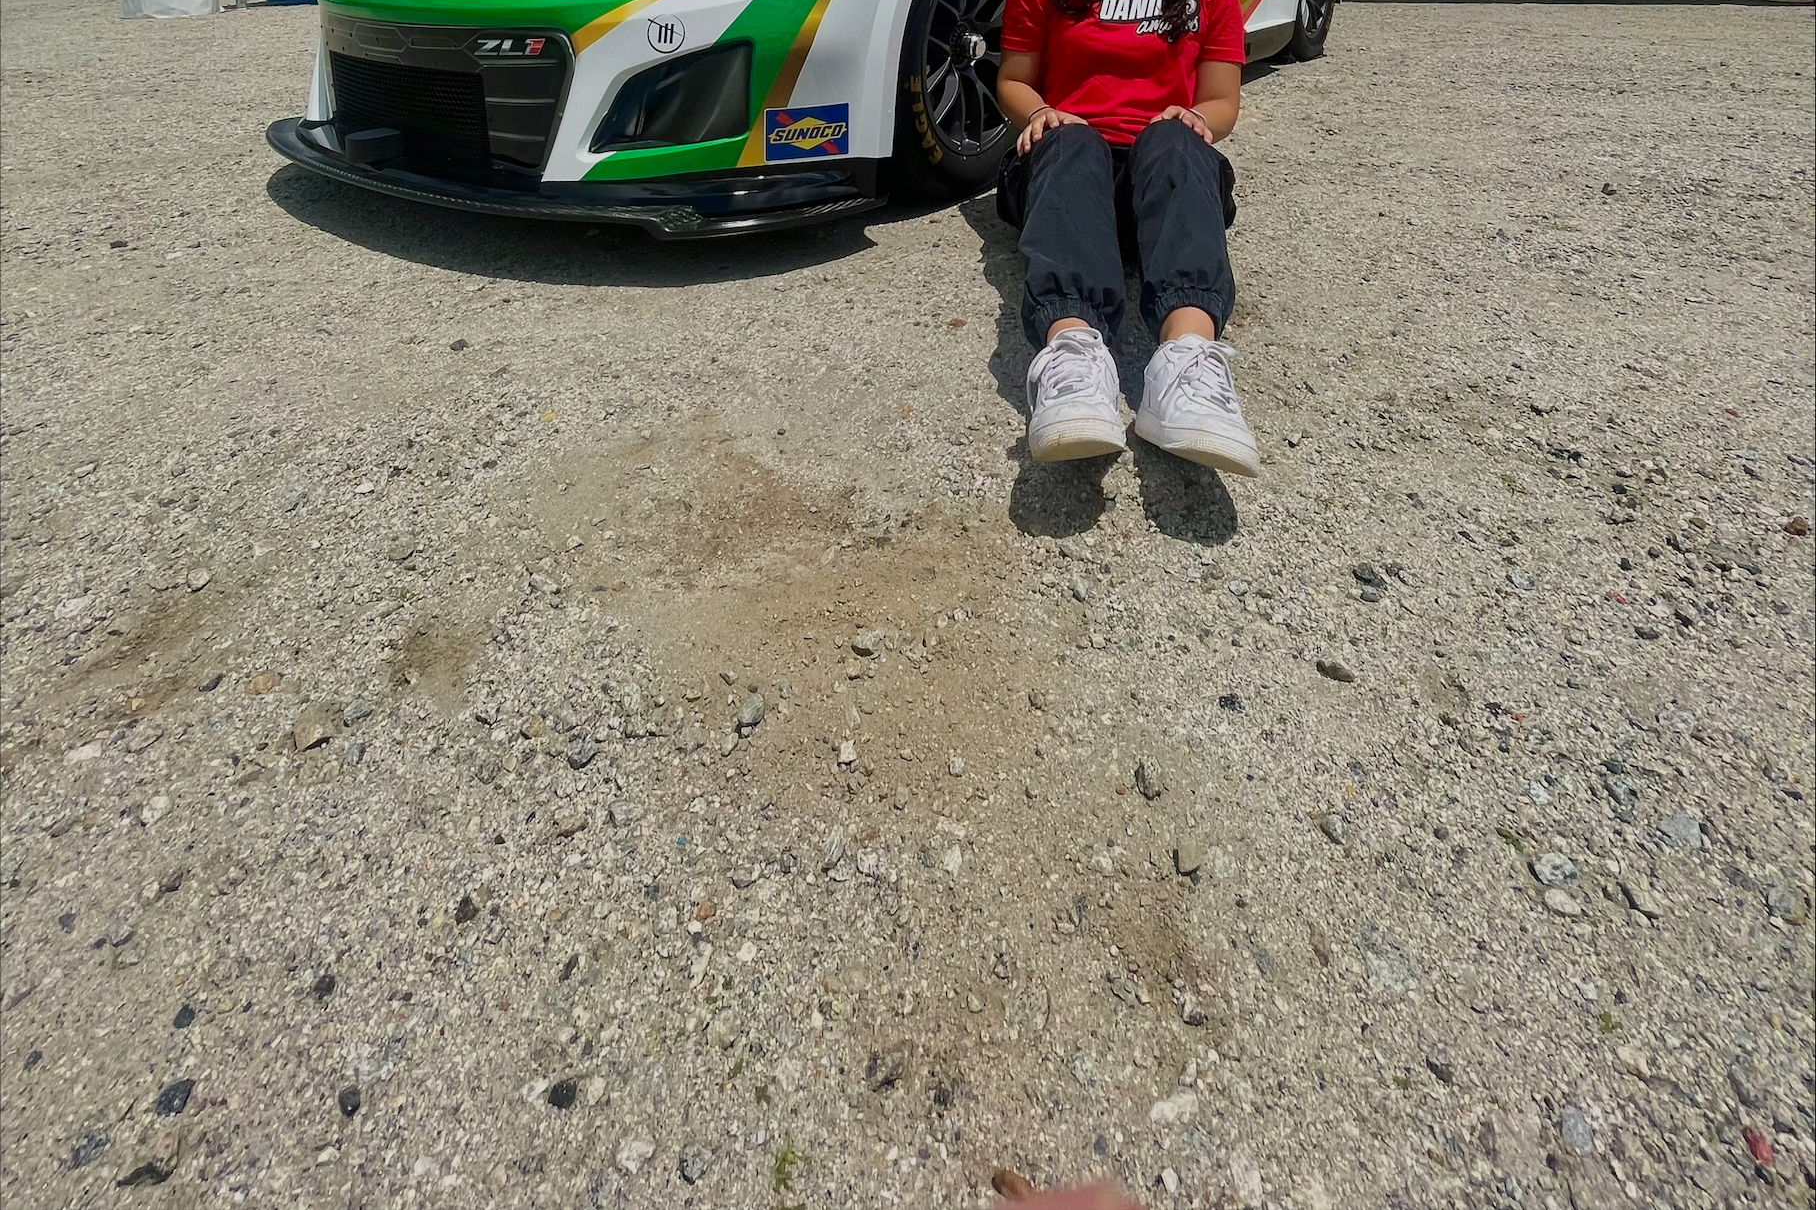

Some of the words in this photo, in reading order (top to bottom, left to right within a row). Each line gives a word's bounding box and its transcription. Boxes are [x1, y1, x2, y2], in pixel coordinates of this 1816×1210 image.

[474, 38, 545, 56] ZL1
[910, 75, 943, 165] EAGLE
[772, 123, 845, 143] SUNOCO
